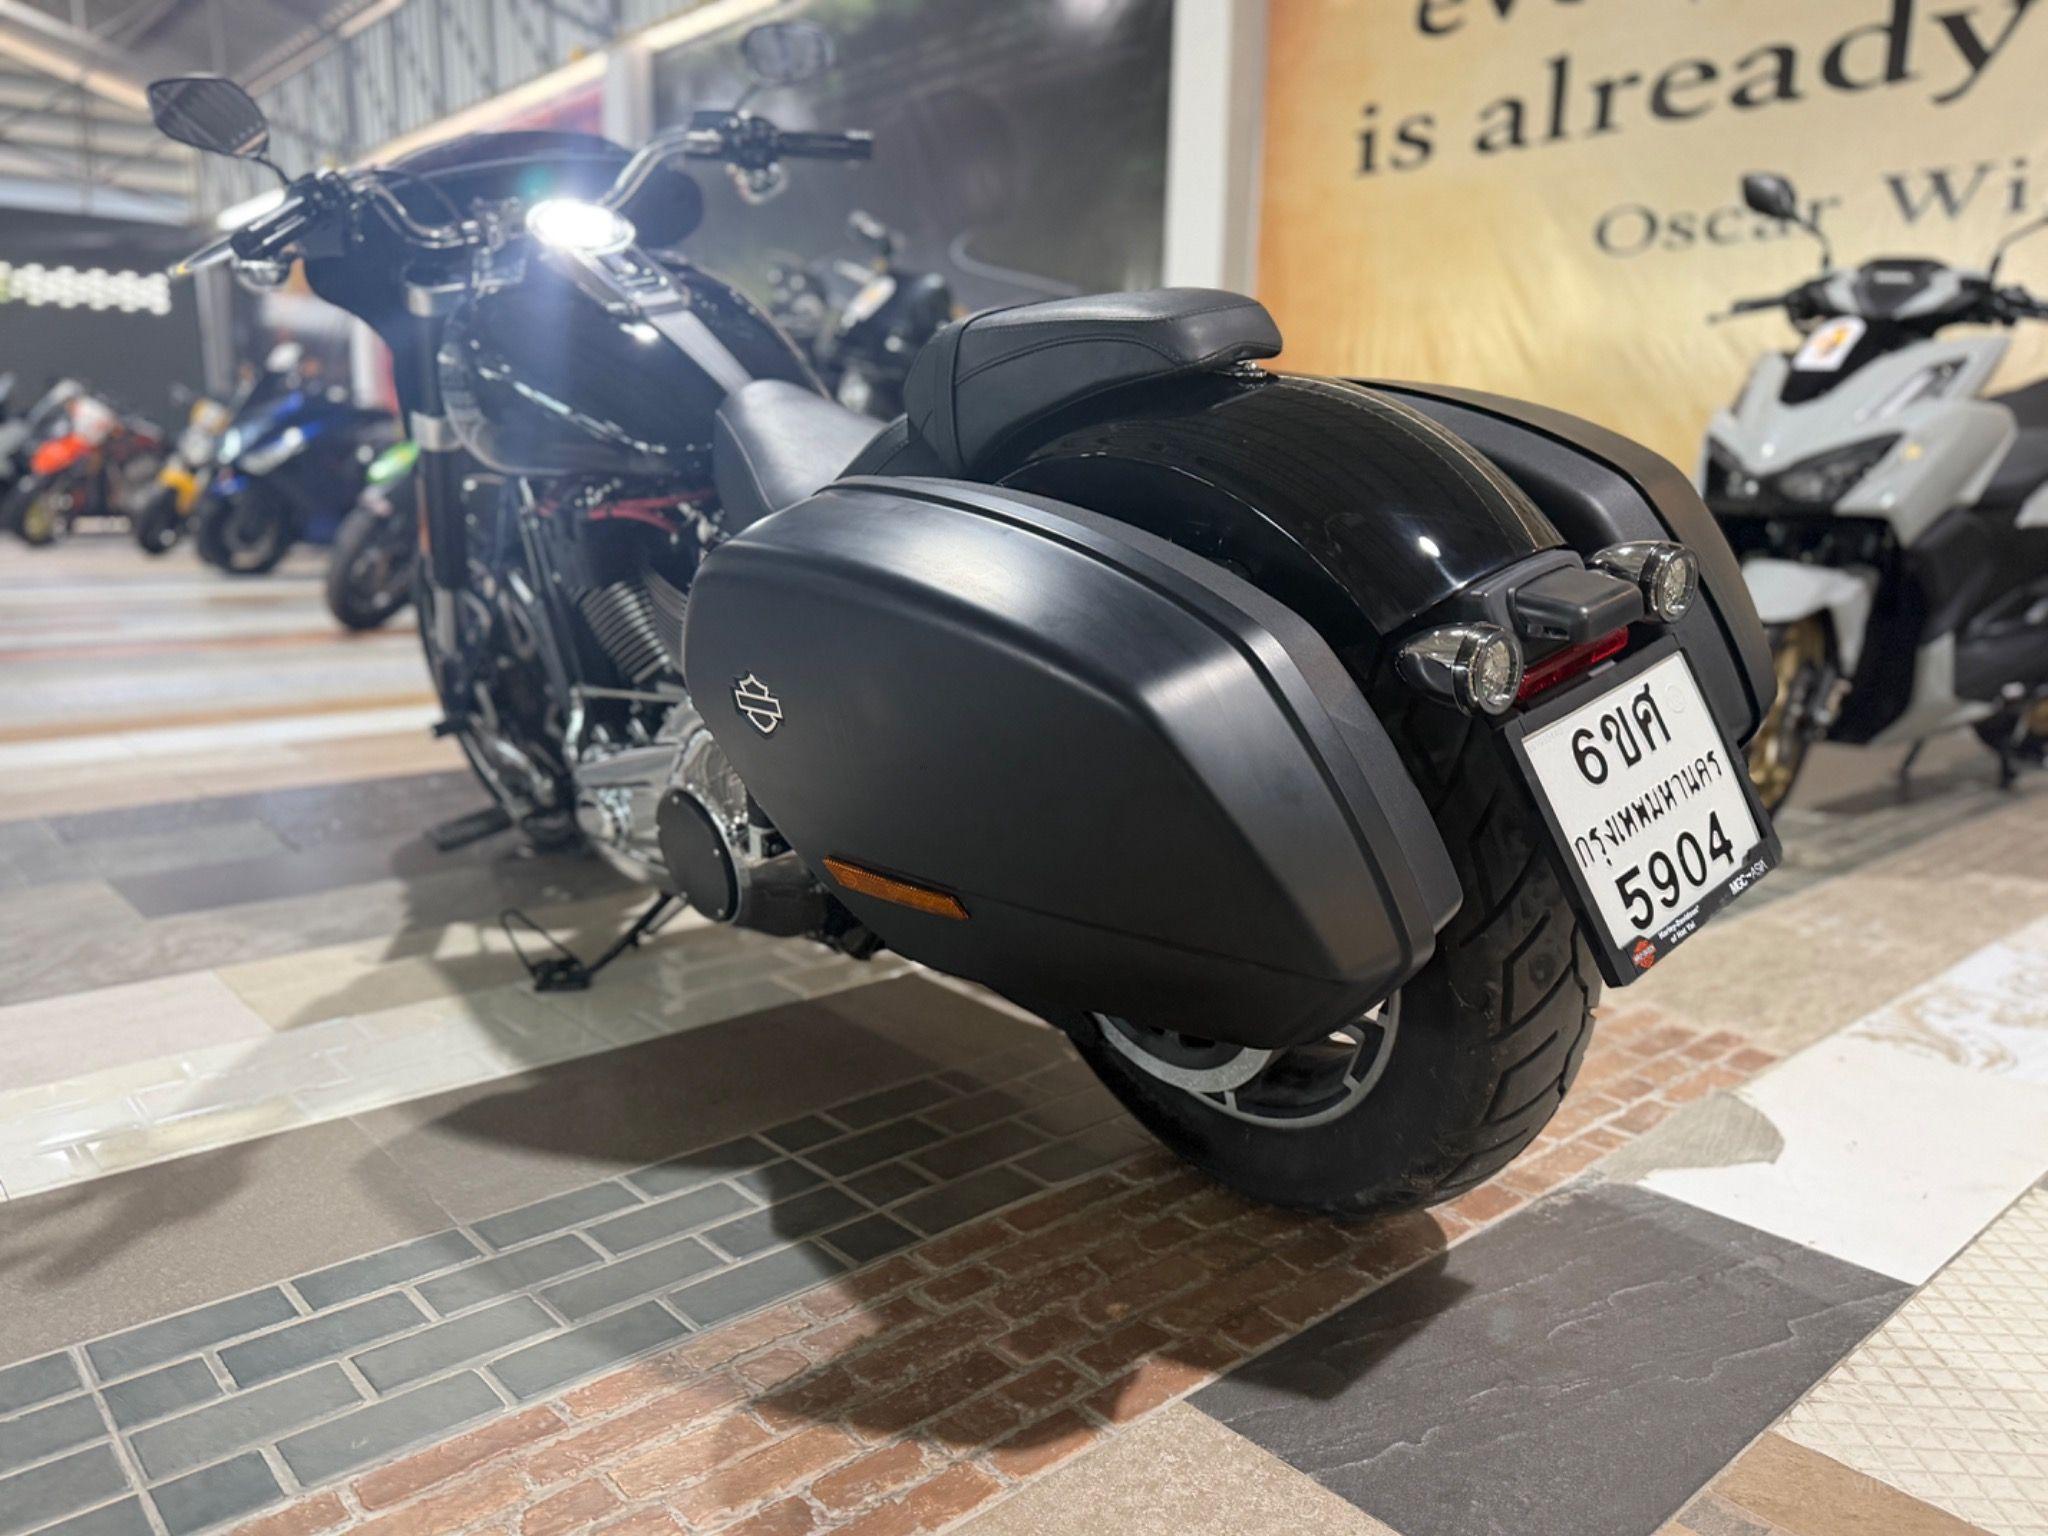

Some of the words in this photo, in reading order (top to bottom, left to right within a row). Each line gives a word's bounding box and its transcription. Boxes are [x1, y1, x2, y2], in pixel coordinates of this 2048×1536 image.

[1356, 103, 1436, 176] is
[1474, 0, 2038, 156] already
[1572, 682, 1672, 785] 6ขศ
[1574, 750, 1722, 867] กรุงเทพมหานคร
[1614, 810, 1735, 930] 5904
